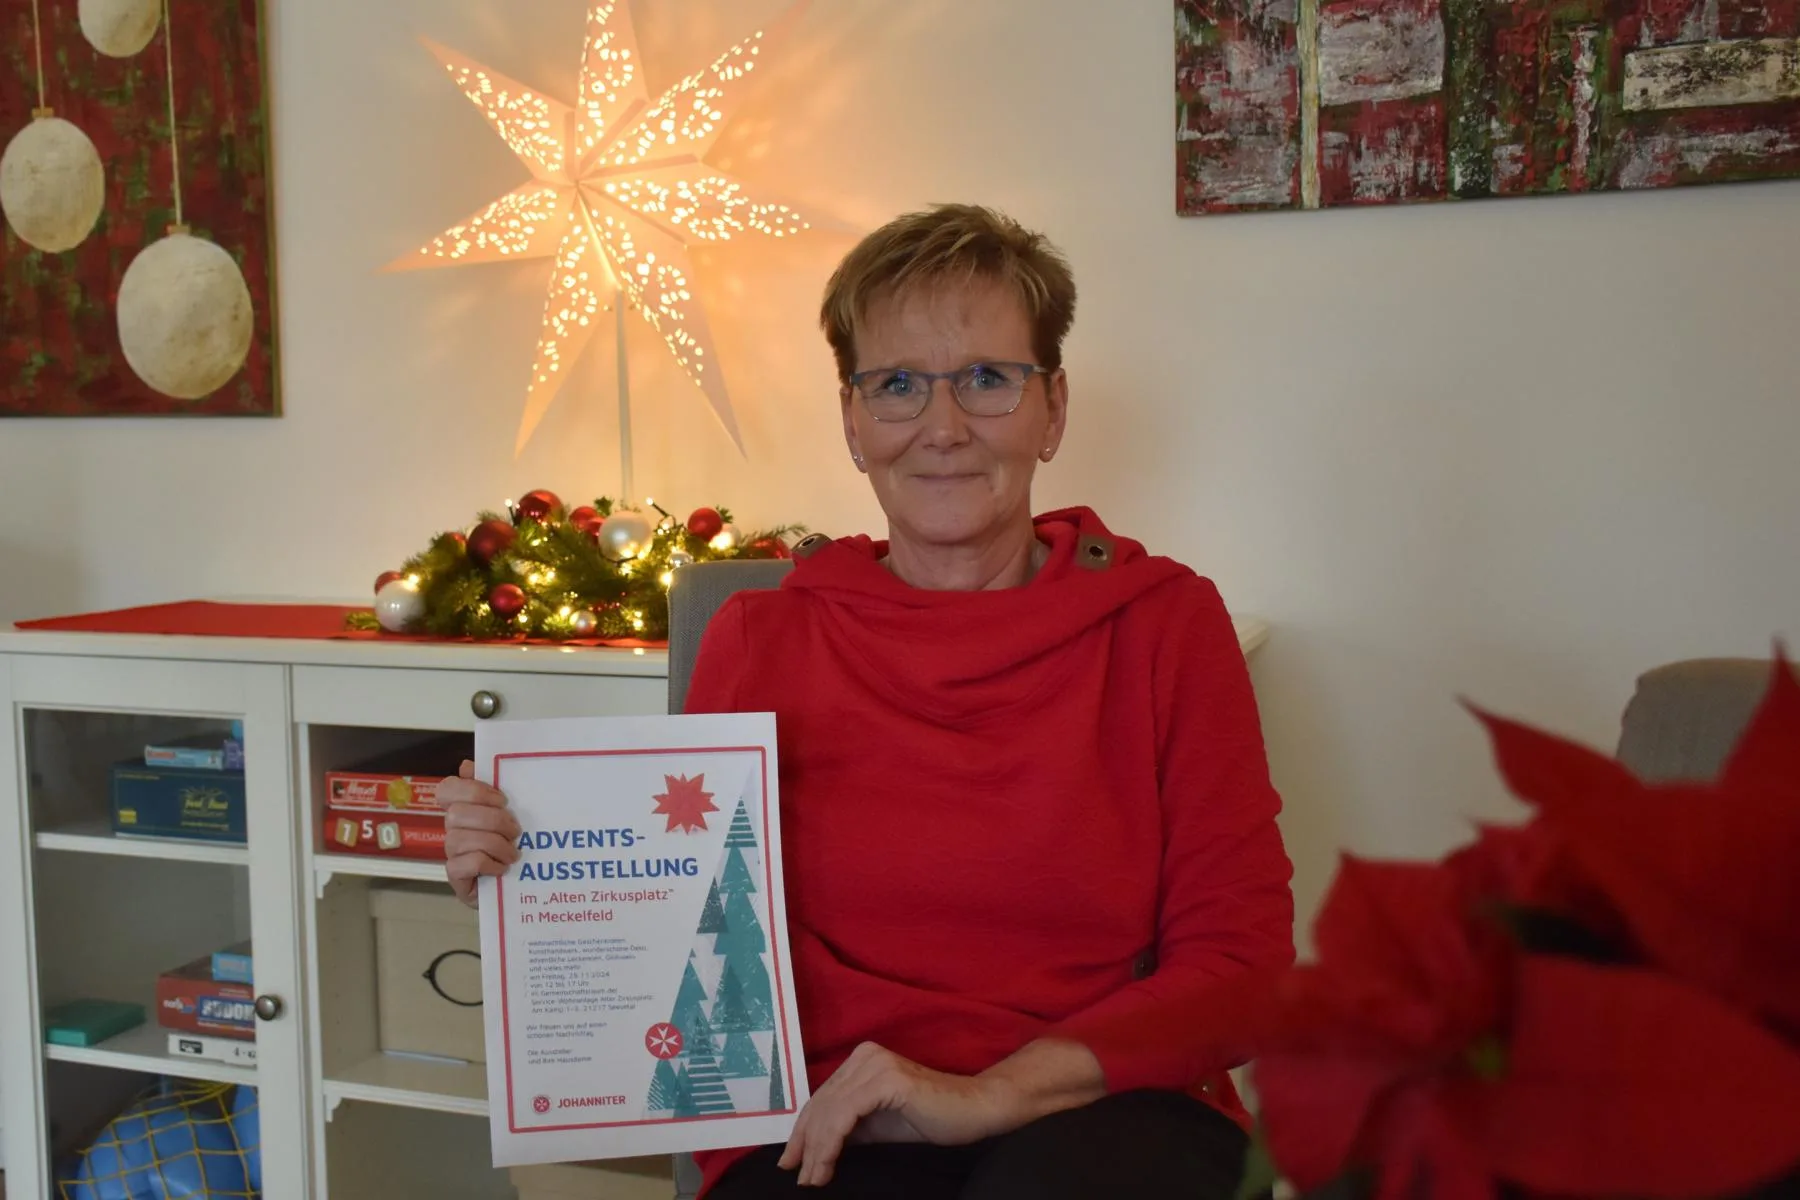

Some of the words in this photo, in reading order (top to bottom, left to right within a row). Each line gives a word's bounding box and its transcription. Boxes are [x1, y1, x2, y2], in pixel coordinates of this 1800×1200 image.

[518, 828, 645, 850] ADVENTS-
[519, 857, 698, 881] AUSSTELLUNG
[520, 893, 537, 904] im
[521, 912, 534, 923] in
[539, 909, 613, 923] Meckelfeld
[557, 1095, 626, 1109] JOHANNITER
